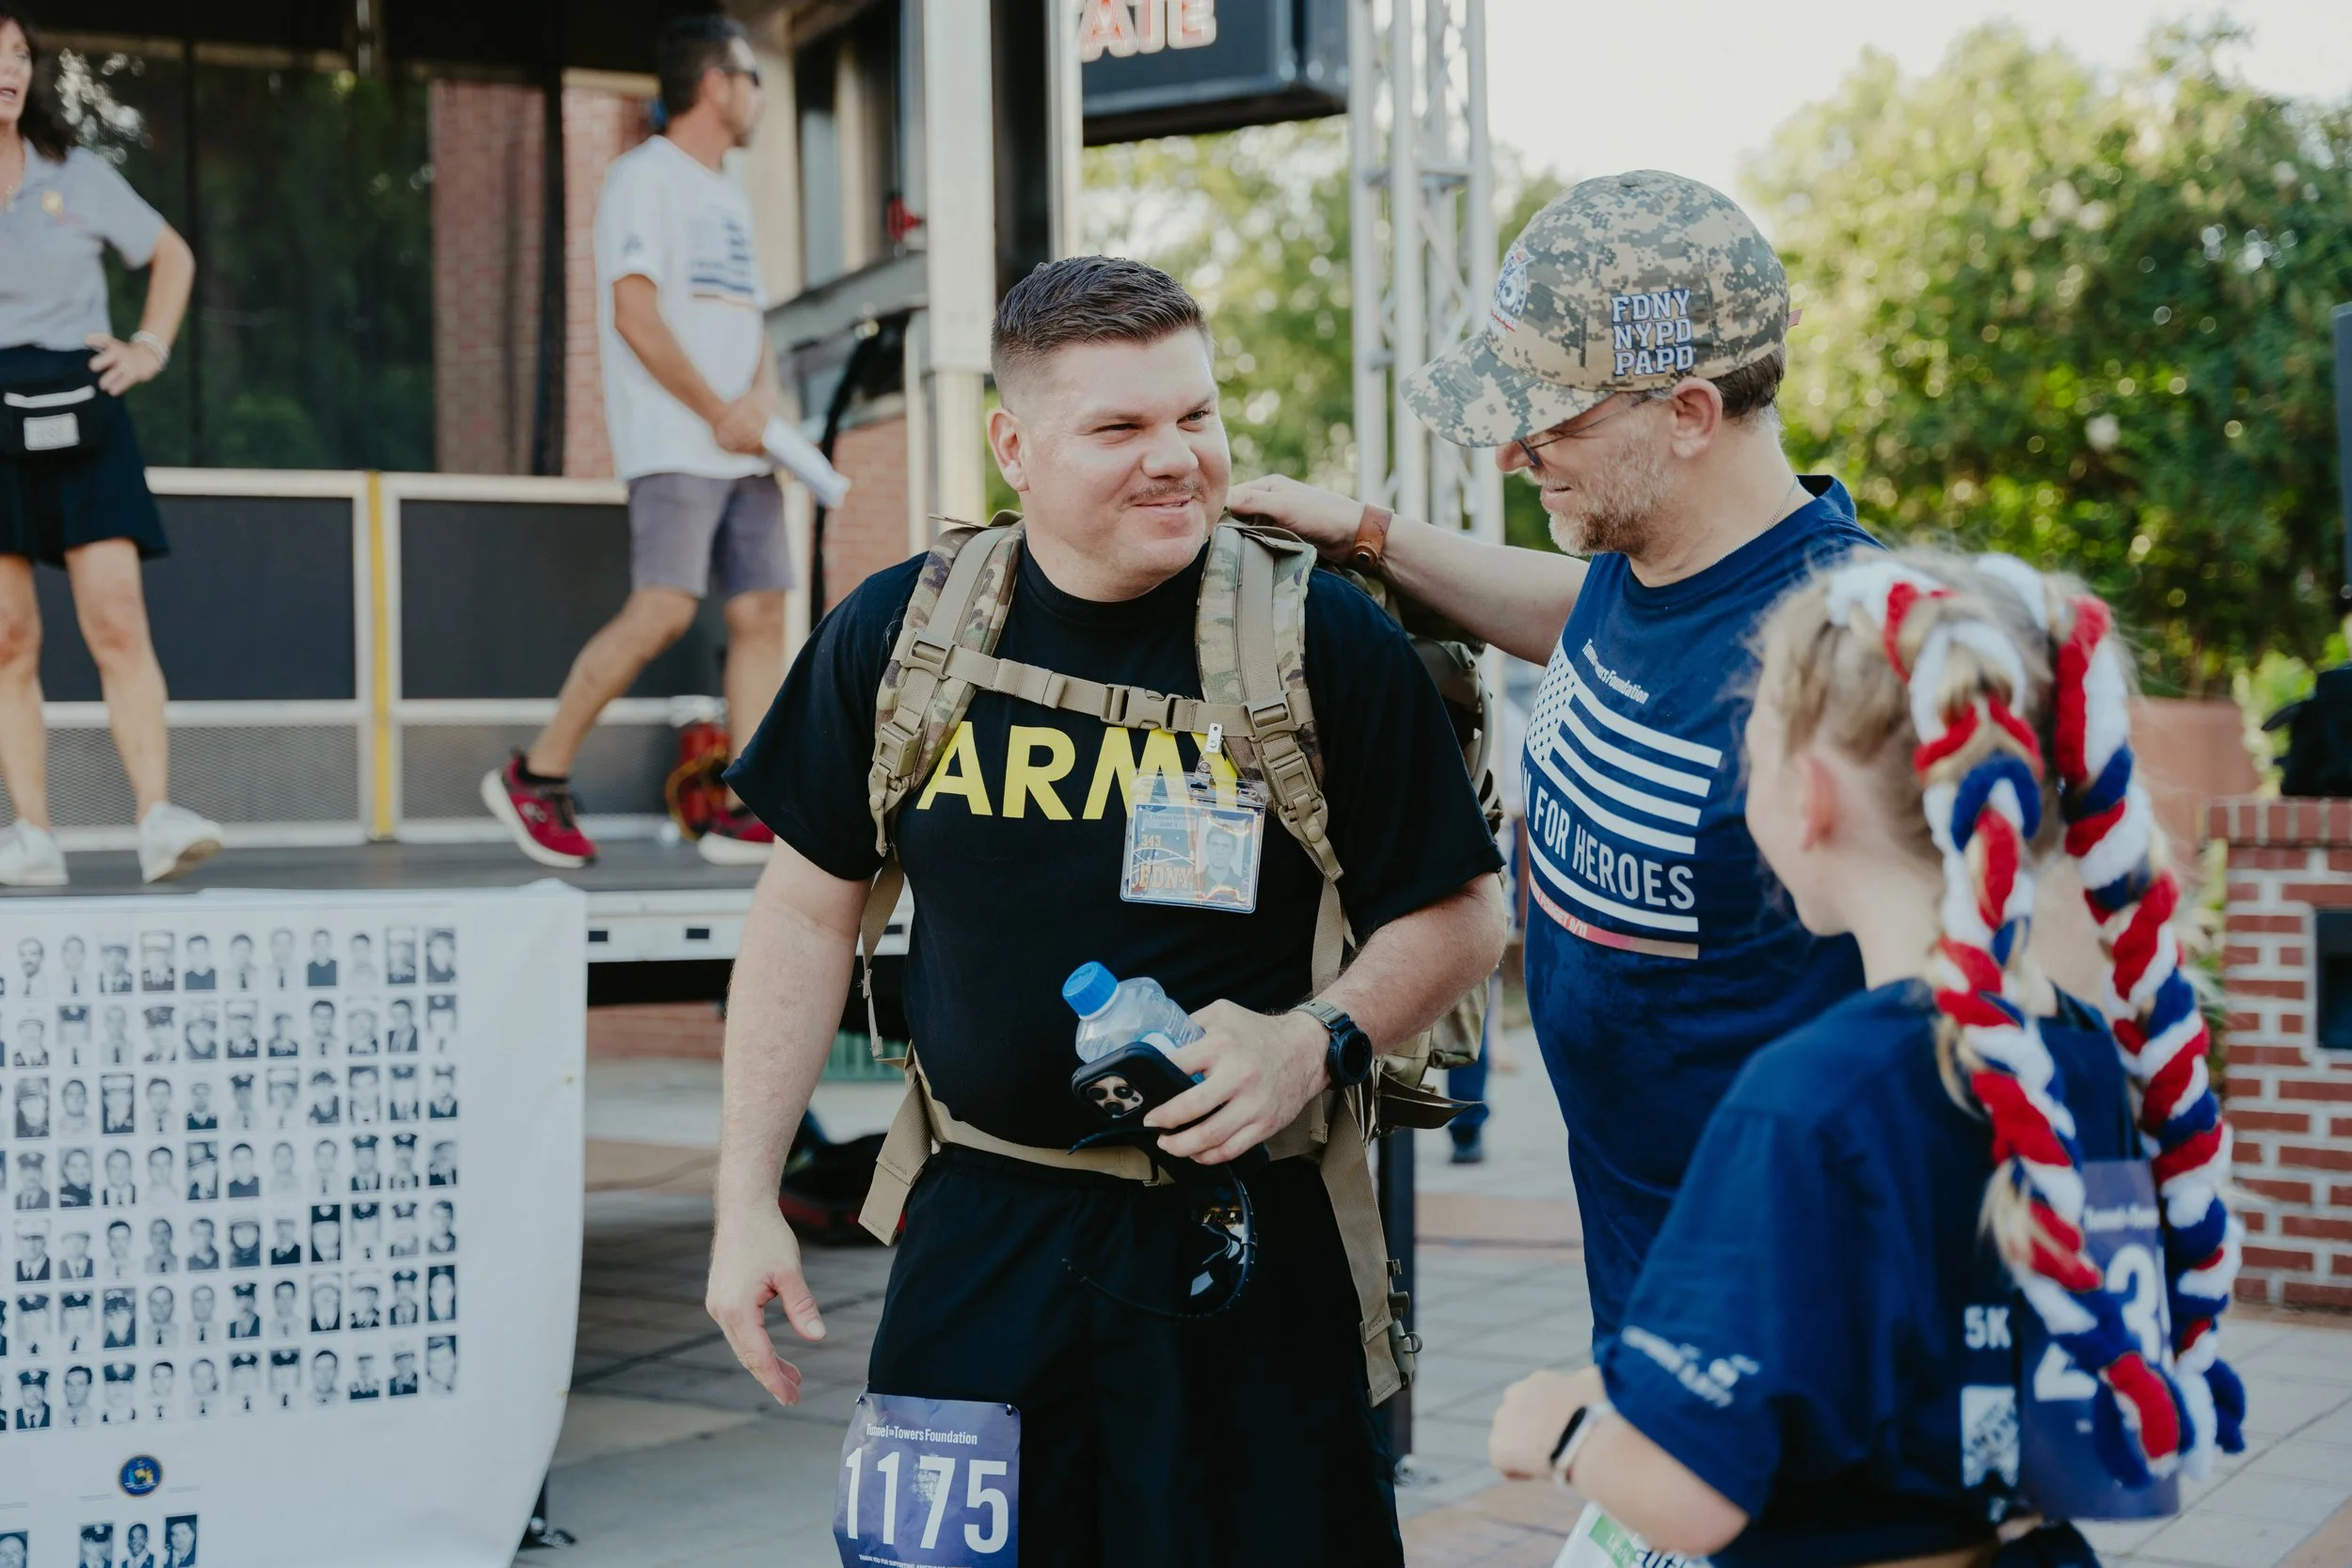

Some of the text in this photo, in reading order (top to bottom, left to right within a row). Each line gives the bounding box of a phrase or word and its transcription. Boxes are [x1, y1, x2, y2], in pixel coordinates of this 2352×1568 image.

[1611, 290, 1691, 323] FDNY
[1613, 319, 1692, 350] NYPD
[1614, 346, 1694, 376] PAPD
[915, 721, 1238, 821] ARMY
[1140, 833, 1162, 847] 343
[1534, 784, 1570, 861] FOR
[1571, 823, 1695, 911] HEROES
[1138, 864, 1193, 891] FDNY
[1963, 1305, 2013, 1351] 5K
[866, 1423, 889, 1438] Tunnel
[893, 1425, 925, 1442] Towers
[925, 1428, 978, 1446] Foundation
[845, 1447, 1009, 1554] 1175
